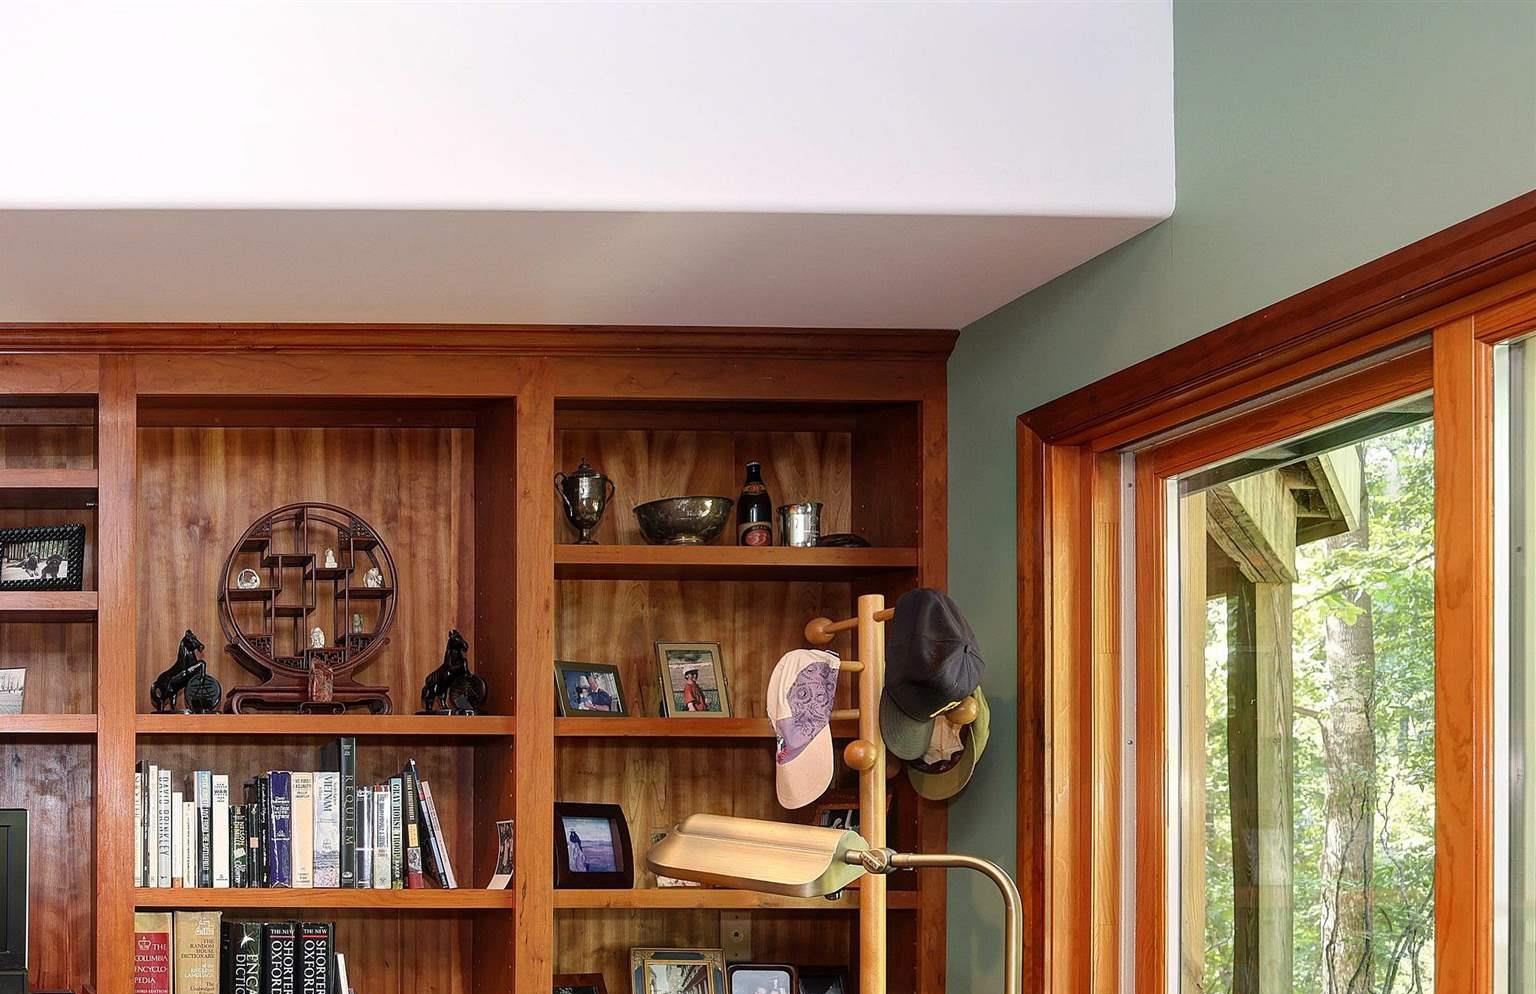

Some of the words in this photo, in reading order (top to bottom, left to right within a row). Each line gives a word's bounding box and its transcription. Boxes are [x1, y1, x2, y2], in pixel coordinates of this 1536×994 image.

[159, 776, 170, 805] DAVID
[324, 776, 333, 812] VIETNAM
[393, 784, 401, 804] GRAY
[345, 775, 353, 845] REQUIEM
[393, 806, 401, 831] HORSE
[159, 810, 170, 855] BRINKLEY
[393, 833, 401, 857] TROOP
